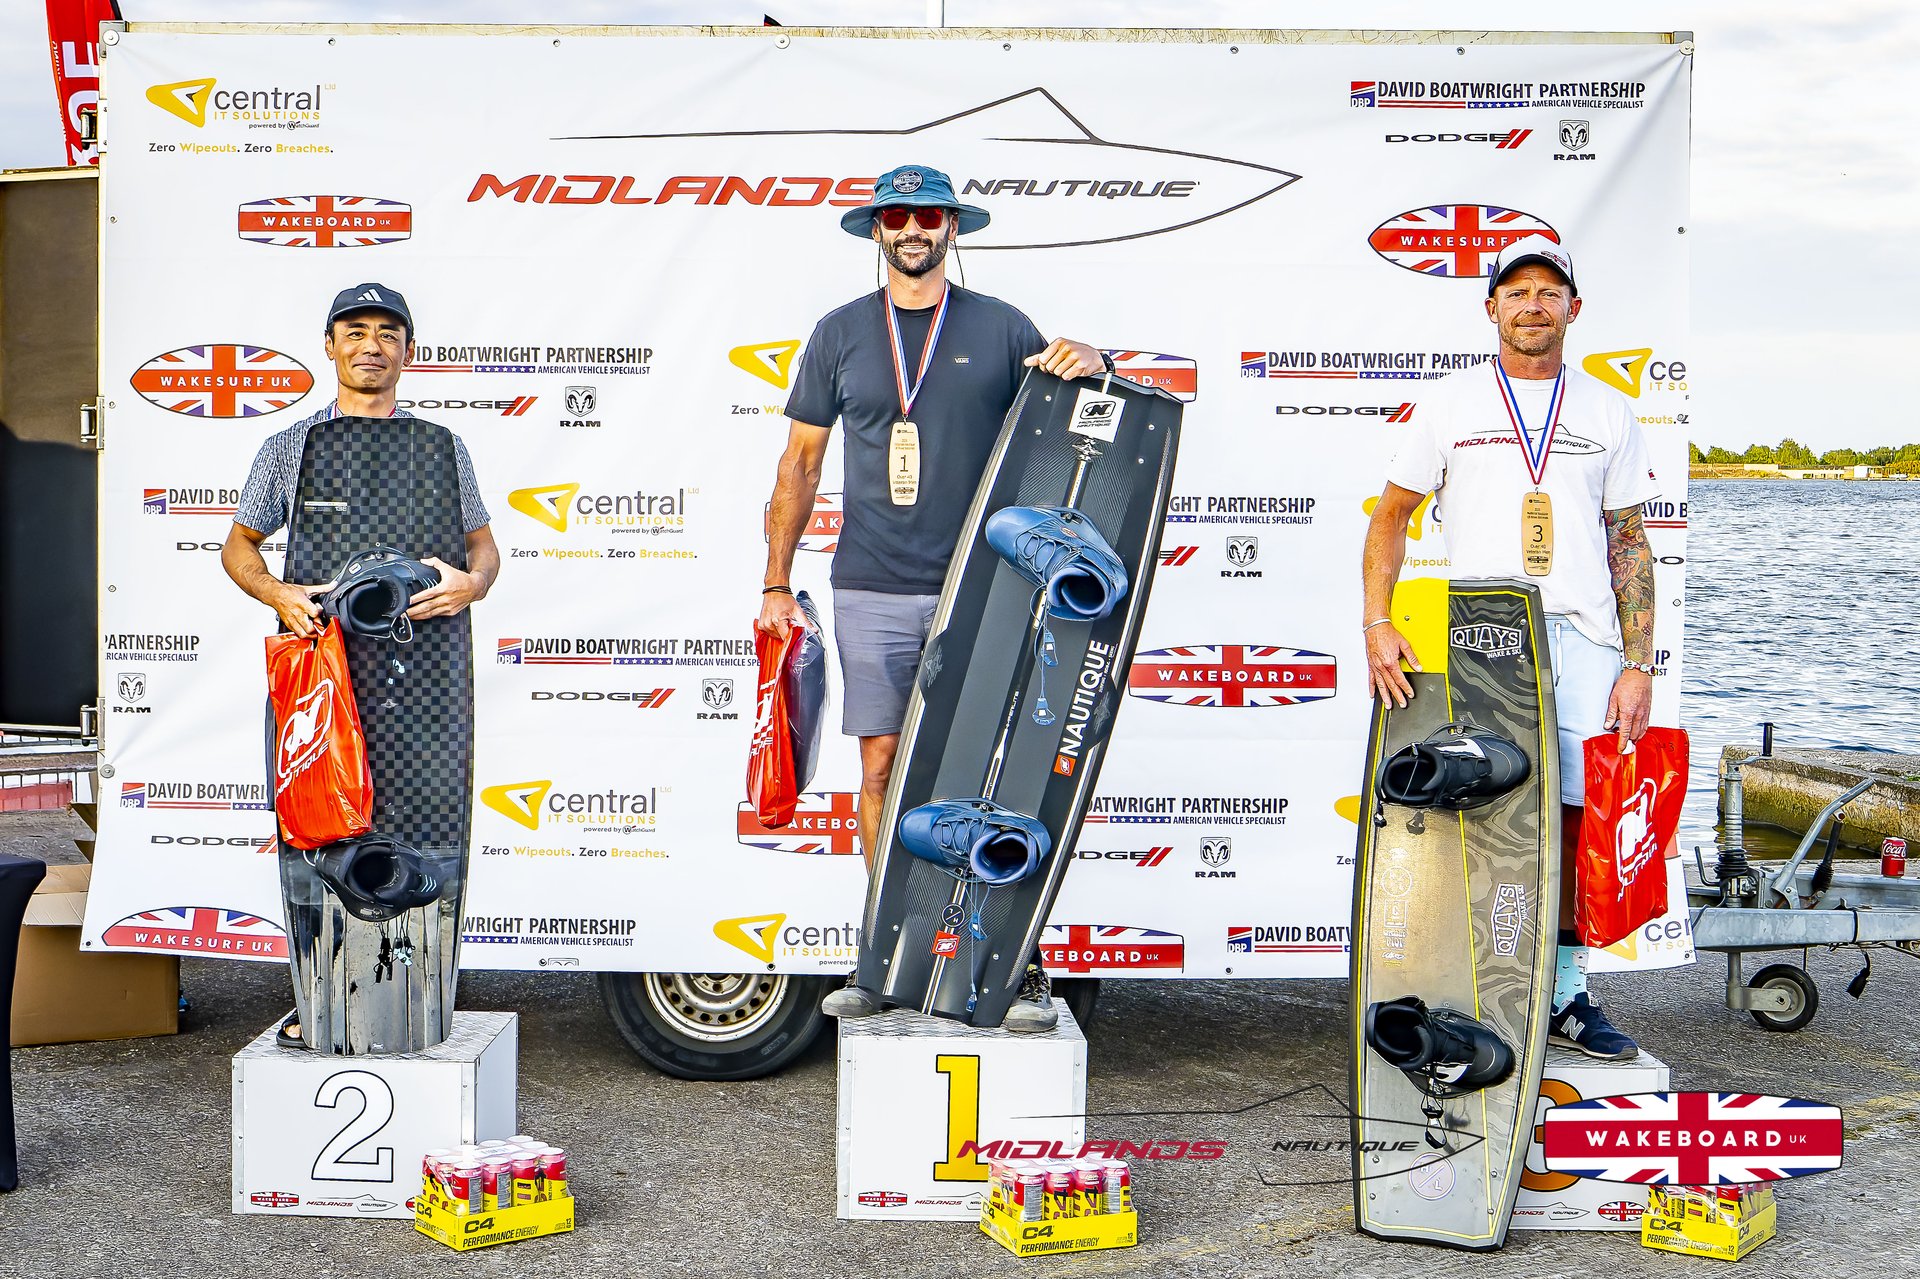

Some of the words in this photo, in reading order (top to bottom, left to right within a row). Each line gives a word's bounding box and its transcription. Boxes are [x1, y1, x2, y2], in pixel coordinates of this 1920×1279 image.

[1378, 81, 1425, 97] DAVID
[1428, 82, 1535, 100] BOATWRIGHT
[1538, 82, 1645, 99] PARTNERSHIP
[213, 83, 320, 111] central
[1350, 97, 1372, 108] DBP
[1573, 100, 1602, 108] VEHICLE
[214, 111, 227, 120] IT
[231, 111, 320, 120] SOLUTIONS
[1385, 132, 1511, 143] DODGE
[149, 143, 175, 152] Zero
[179, 143, 240, 154] Wipeouts.
[244, 144, 272, 152] Zero
[276, 144, 333, 153] Breaches.
[467, 173, 878, 207] MIDLANDS
[961, 179, 1197, 199] NAUTIQUE
[262, 215, 376, 229] WAKEBOARD
[1401, 235, 1508, 247] WAKESURF
[437, 346, 540, 362] BOATWRIGHT
[544, 347, 653, 364] PARTNERSHIP
[954, 357, 970, 365] VANS
[1269, 352, 1318, 367] DAVID
[1320, 353, 1426, 370] BOATWRIGHT
[578, 366, 608, 374] VEHICLE
[610, 366, 650, 374] SPECIALIST
[1241, 368, 1262, 378] DBP
[160, 375, 264, 387] WAKESURF
[271, 375, 292, 387] UK
[1650, 381, 1663, 391] IT
[396, 399, 515, 410] DODGE
[732, 405, 759, 414] Zero
[1276, 406, 1401, 416] DODGE
[899, 454, 909, 473] 1
[169, 489, 210, 504] DAVID
[575, 486, 683, 516] central
[144, 504, 163, 515] DBP
[1208, 497, 1315, 513] PARTNERSHIP
[576, 516, 589, 524] IT
[595, 516, 684, 526] SOLUTIONS
[1199, 515, 1238, 523] AMERICAN
[1240, 516, 1271, 524] VEHICLE
[1272, 516, 1313, 524] SPECIALIST
[642, 528, 650, 536] by
[1532, 524, 1544, 543] 3
[511, 548, 538, 557] Zero
[543, 549, 603, 560] Wipeouts.
[608, 549, 635, 558] Zero
[640, 549, 697, 559] Breaches.
[1453, 626, 1519, 649] QUAYS
[525, 639, 571, 654] DAVID
[576, 639, 678, 656] BOATWRIGHT
[684, 639, 755, 656] PARTNER
[129, 653, 158, 661] VEHICLE
[158, 653, 198, 661] SPECIALIST
[496, 654, 517, 665] DBP
[1486, 650, 1505, 659] WAKE
[675, 658, 713, 666] AMERICAN
[716, 658, 746, 666] VEHICLE
[1157, 669, 1295, 683] WAKEBOARD
[531, 691, 654, 702] DODGE
[1059, 640, 1110, 757] NAUTIQUE
[148, 783, 192, 798] DAVID
[120, 797, 141, 809] DBP
[547, 786, 656, 814] central
[1182, 798, 1288, 813] PARTNERSHIP
[548, 814, 561, 823] IT
[567, 813, 656, 825] SOLUTIONS
[1173, 816, 1212, 824] AMERICAN
[613, 827, 622, 835] by
[150, 835, 270, 847] DODGE
[482, 846, 509, 855] Zero
[514, 847, 574, 858] Wipeouts.
[579, 847, 607, 857] Zero
[611, 848, 669, 858] Breaches.
[1495, 887, 1518, 953] QUAYS
[527, 918, 636, 936] PARTNERSHIP
[1255, 927, 1301, 942] DAVID
[134, 932, 244, 949] WAKESURF
[251, 940, 273, 953] UK
[521, 937, 560, 945] AMERICAN
[561, 937, 592, 945] VEHICLE
[590, 938, 633, 946] SPECIALIST
[1227, 942, 1248, 953] DBP
[783, 947, 796, 956] IT
[1146, 953, 1159, 961] UK
[849, 959, 857, 967] by
[932, 1054, 989, 1182] 1
[311, 1069, 395, 1183] 2
[306, 1200, 354, 1208] MIDLANDS
[416, 1202, 433, 1219] C4
[464, 1217, 496, 1234] C4
[1649, 1218, 1684, 1232] C4
[462, 1230, 515, 1248] PERFORMANCE
[515, 1225, 540, 1238] ENERGY
[1022, 1225, 1055, 1240] C4
[1020, 1239, 1074, 1254] PERFORMANCE
[1074, 1236, 1100, 1248] ENERGY
